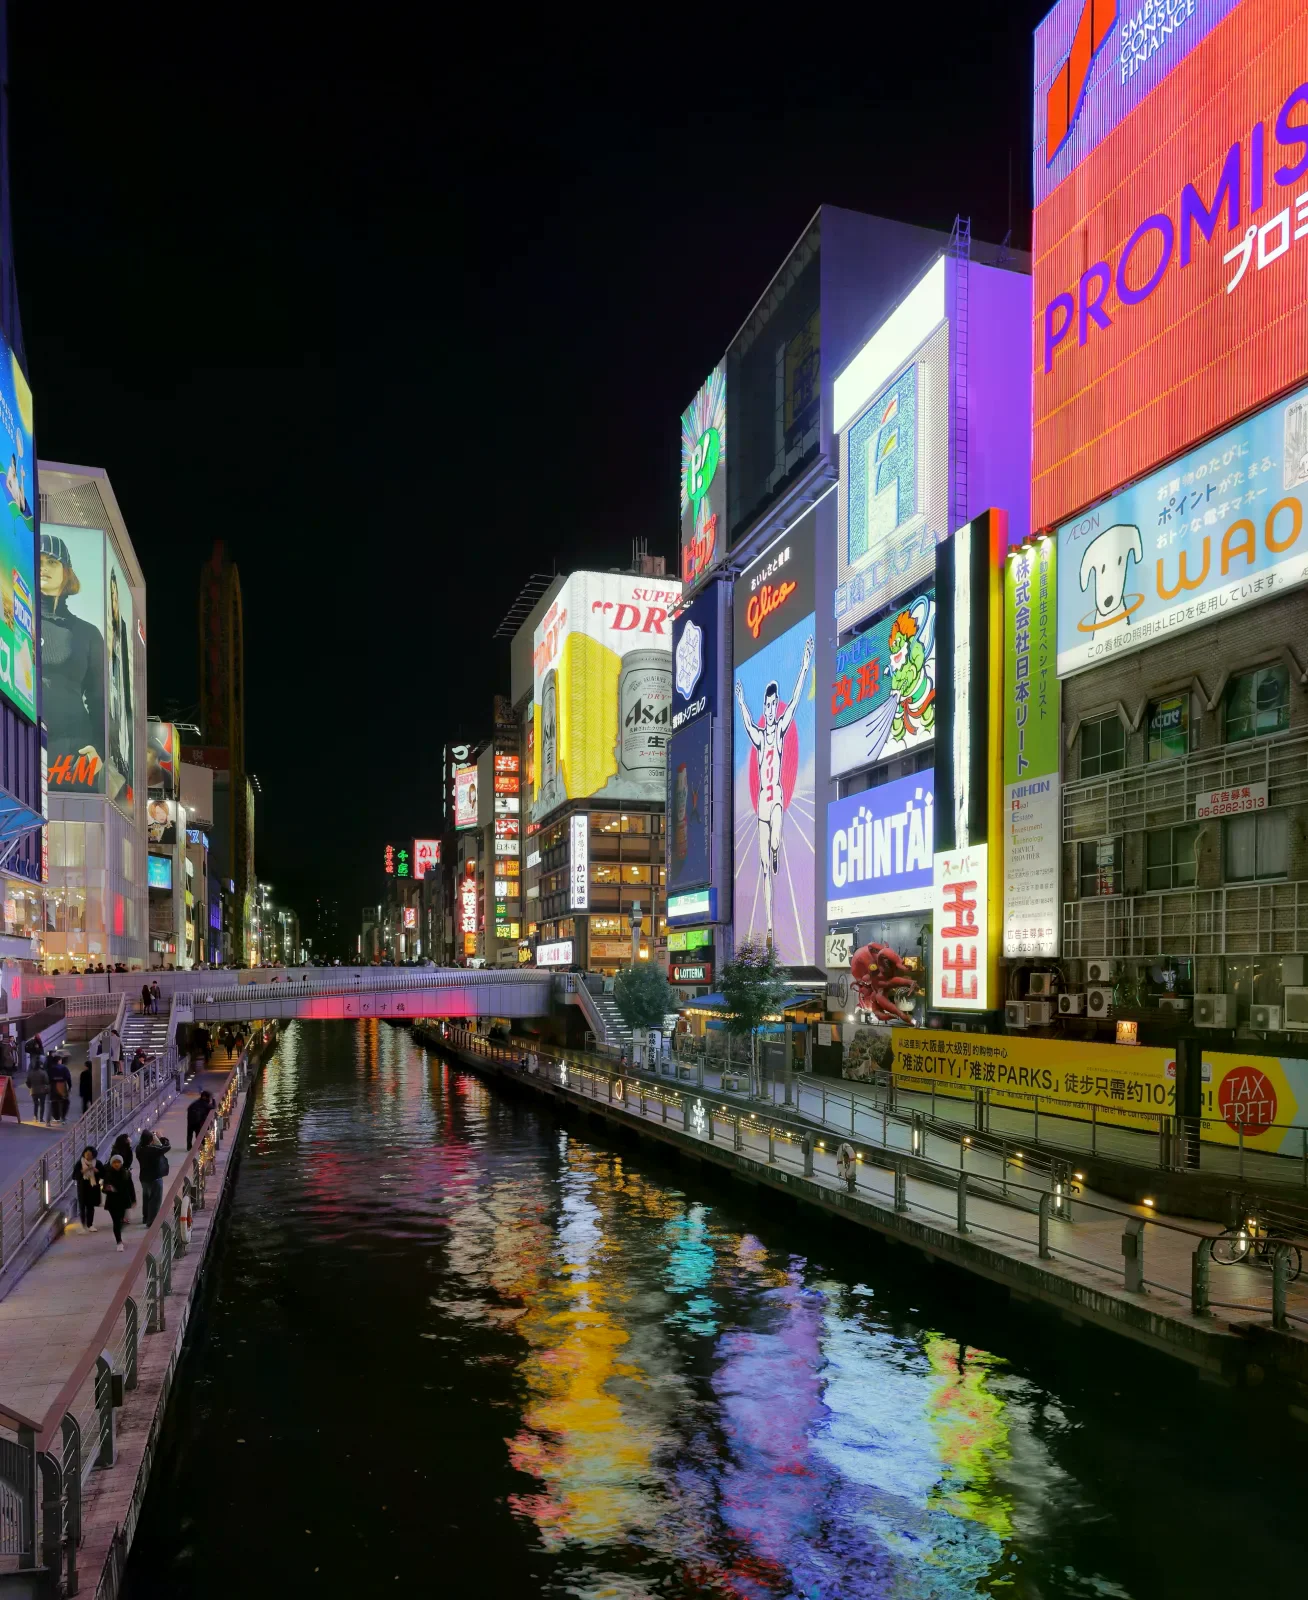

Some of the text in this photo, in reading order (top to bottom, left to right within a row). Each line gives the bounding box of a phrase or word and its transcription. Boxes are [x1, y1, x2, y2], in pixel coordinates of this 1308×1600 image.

[1121, 0, 1182, 63] CONSU
[1122, 0, 1163, 46] SMB
[1122, 0, 1196, 86] FINANCE
[1157, 441, 1249, 501] お買物のたびに
[1158, 456, 1277, 525] ポイントがたまる、
[1156, 486, 1268, 549] おトクな電子マネー
[1087, 573, 1284, 658] この看板の照明はLEDを使用しています。
[1038, 547, 1049, 721] 不動産再生のスペシャリスト
[1014, 556, 1030, 776] 株式会社日本リート
[831, 657, 881, 716] 改源
[647, 736, 665, 748] 生
[47, 753, 99, 787] H&M
[766, 747, 775, 802] グリコ
[1011, 780, 1050, 799] NIHON
[1210, 787, 1251, 804] 広告募集
[1011, 811, 1034, 823] Estate
[1198, 798, 1265, 818] 06-6262-1313
[832, 787, 934, 888] CHINTAI
[1011, 823, 1043, 835] Investment
[1011, 834, 1044, 846] Technology
[943, 854, 979, 879] スーパー
[941, 880, 980, 1000] 玉出
[1008, 928, 1053, 940] 広告主募集中
[680, 967, 704, 980] LOTTERIA
[1117, 1022, 1136, 1034] BAR
[1226, 1074, 1265, 1101] TAX
[1223, 1100, 1274, 1126] FREE!
